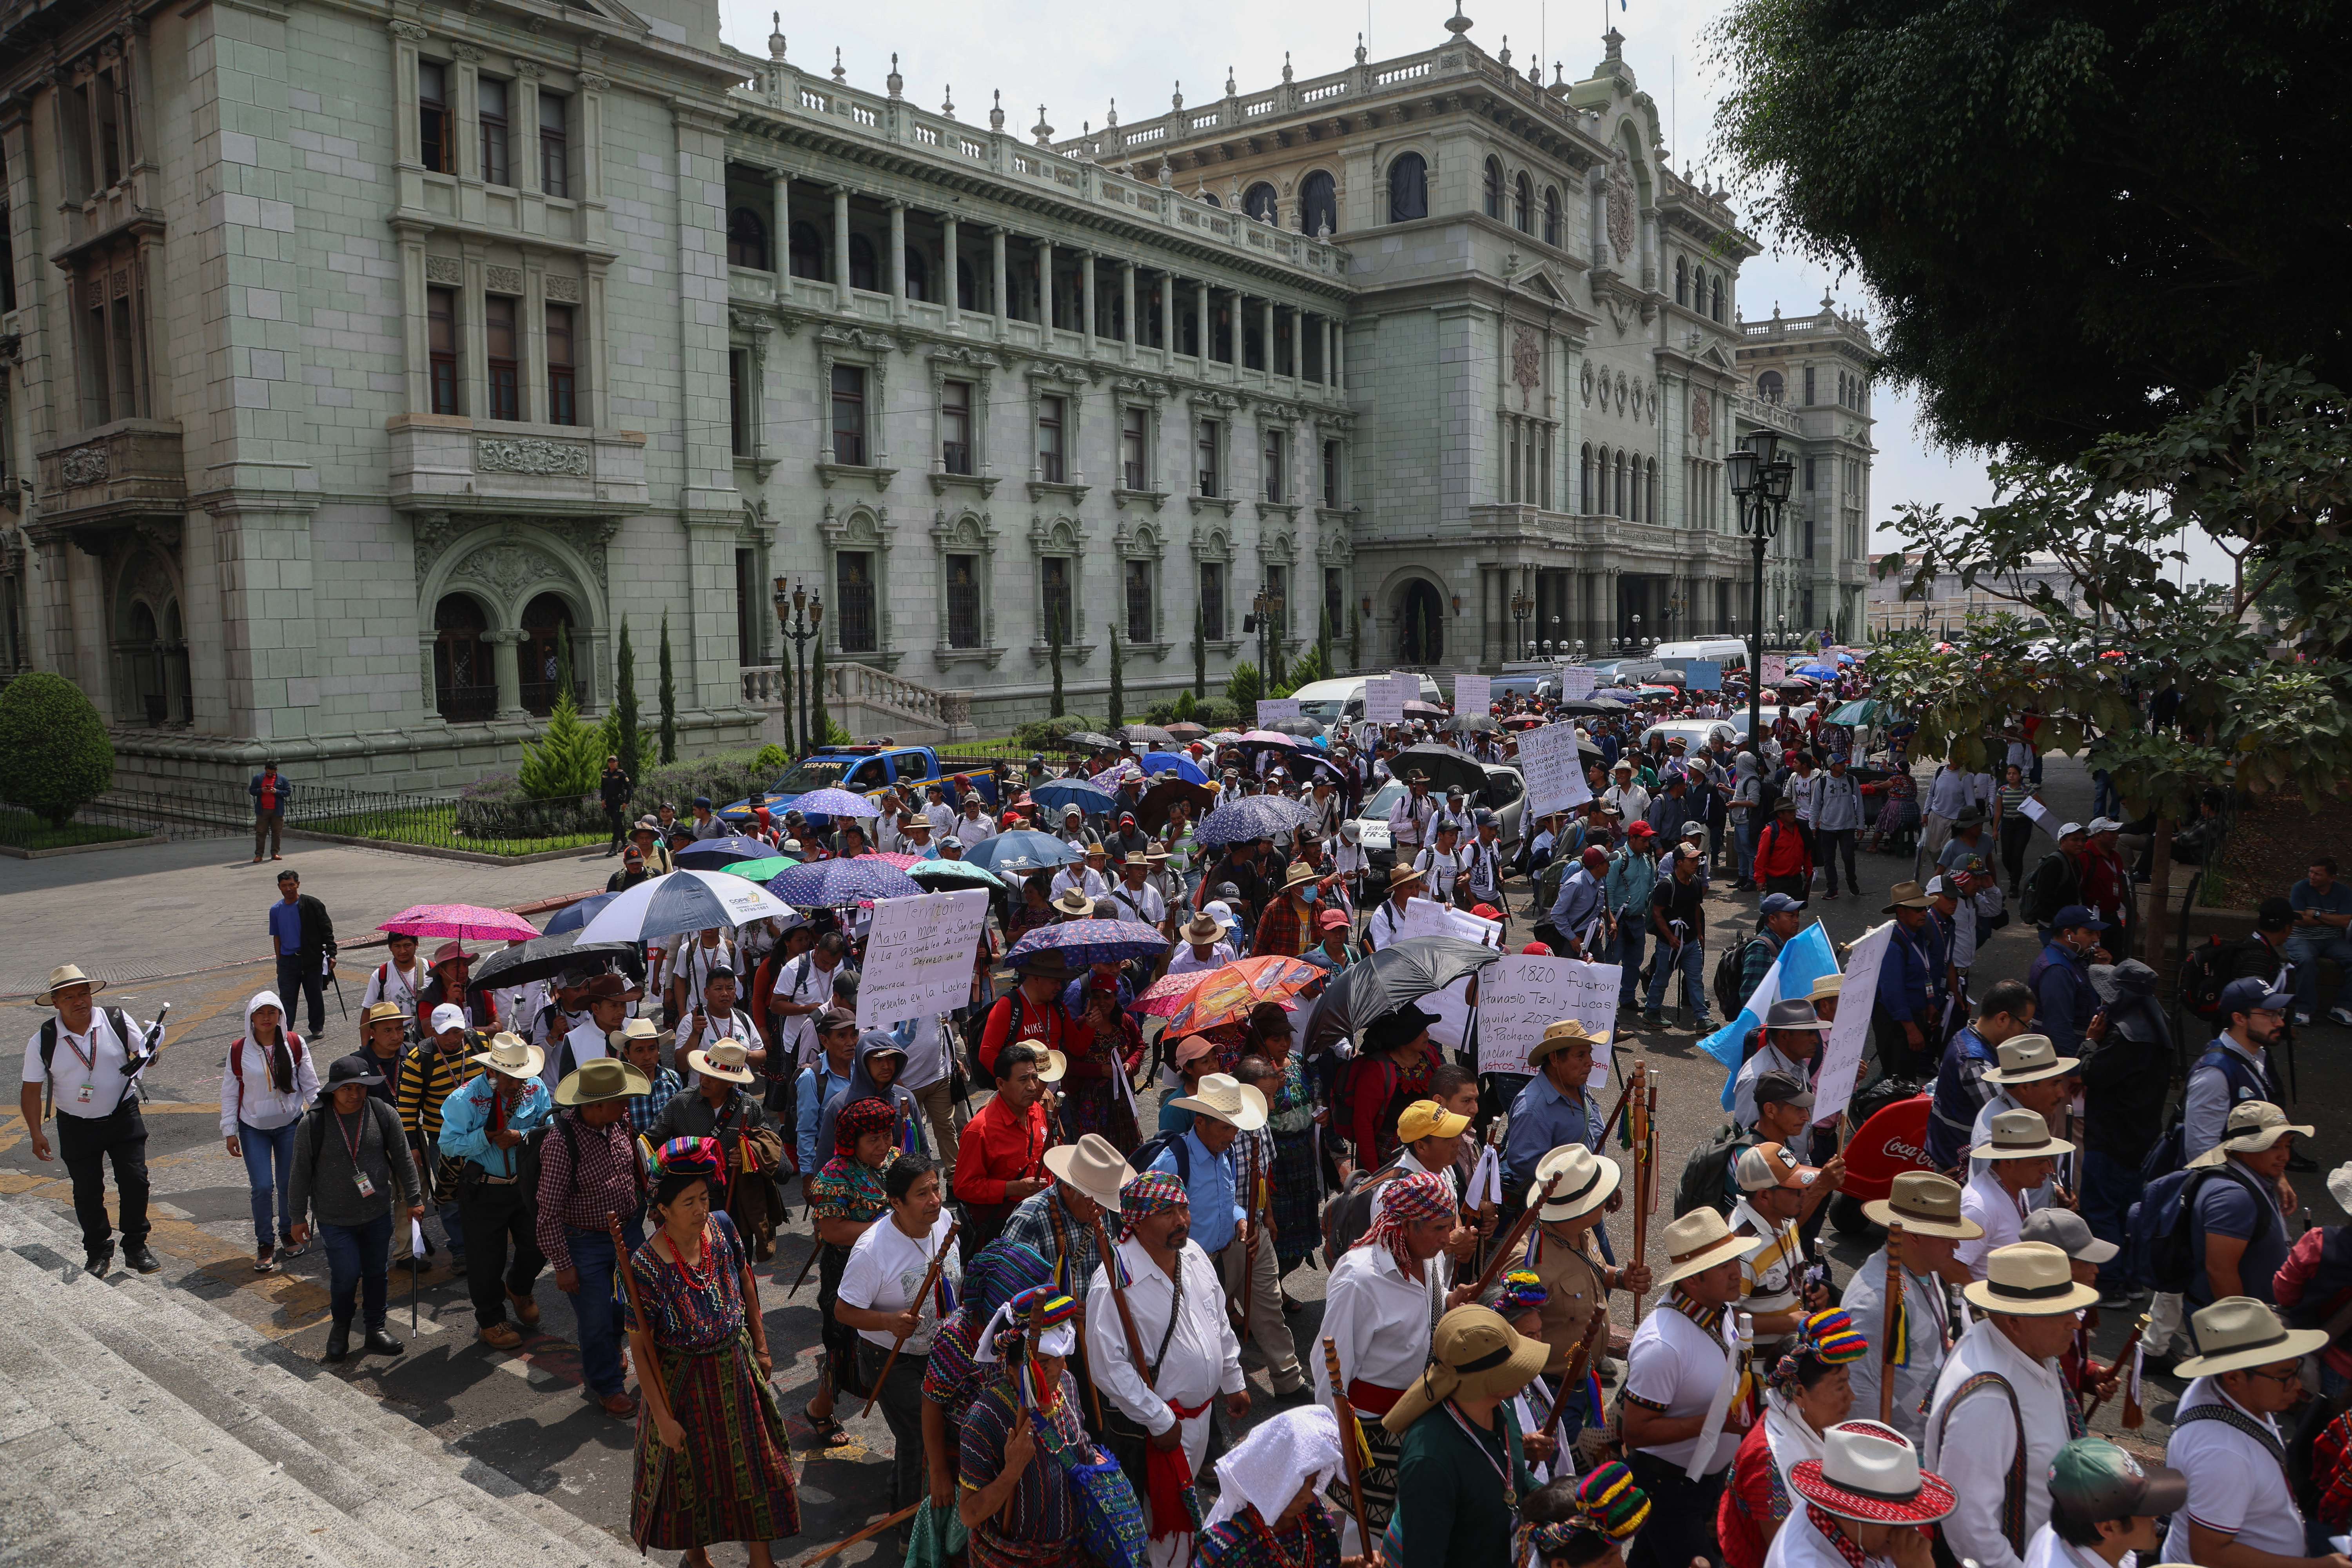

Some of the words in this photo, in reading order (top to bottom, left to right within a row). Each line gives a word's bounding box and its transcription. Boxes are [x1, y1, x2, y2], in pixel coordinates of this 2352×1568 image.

[1259, 703, 1281, 712] Diputado
[1518, 724, 1558, 742] REFORMAS
[1522, 745, 1559, 760] DIPUTADOS
[1525, 768, 1536, 777] por
[1537, 770, 1555, 779] acaba
[1528, 774, 1564, 790] Absentismo
[1530, 786, 1550, 797] reduce
[1534, 786, 1577, 804] CORRUPCION
[904, 901, 964, 922] Territorio
[1409, 905, 1419, 921] Por
[1423, 909, 1428, 924] la
[945, 922, 953, 934] de
[900, 941, 940, 957] asamblea
[944, 937, 951, 946] de
[964, 934, 979, 943] Pueblos
[1483, 964, 1506, 984] En
[1567, 971, 1615, 992] fueron
[872, 995, 907, 1011] Presentes
[911, 994, 921, 1002] en
[926, 984, 934, 998] la
[1479, 992, 1525, 1008] Atanasio
[1529, 992, 1556, 1005] Tzul
[1558, 1000, 1567, 1010] y
[1024, 1022, 1043, 1035] NIKE
[1577, 1018, 1604, 1030] son
[1494, 1027, 1534, 1042] Pacheco
